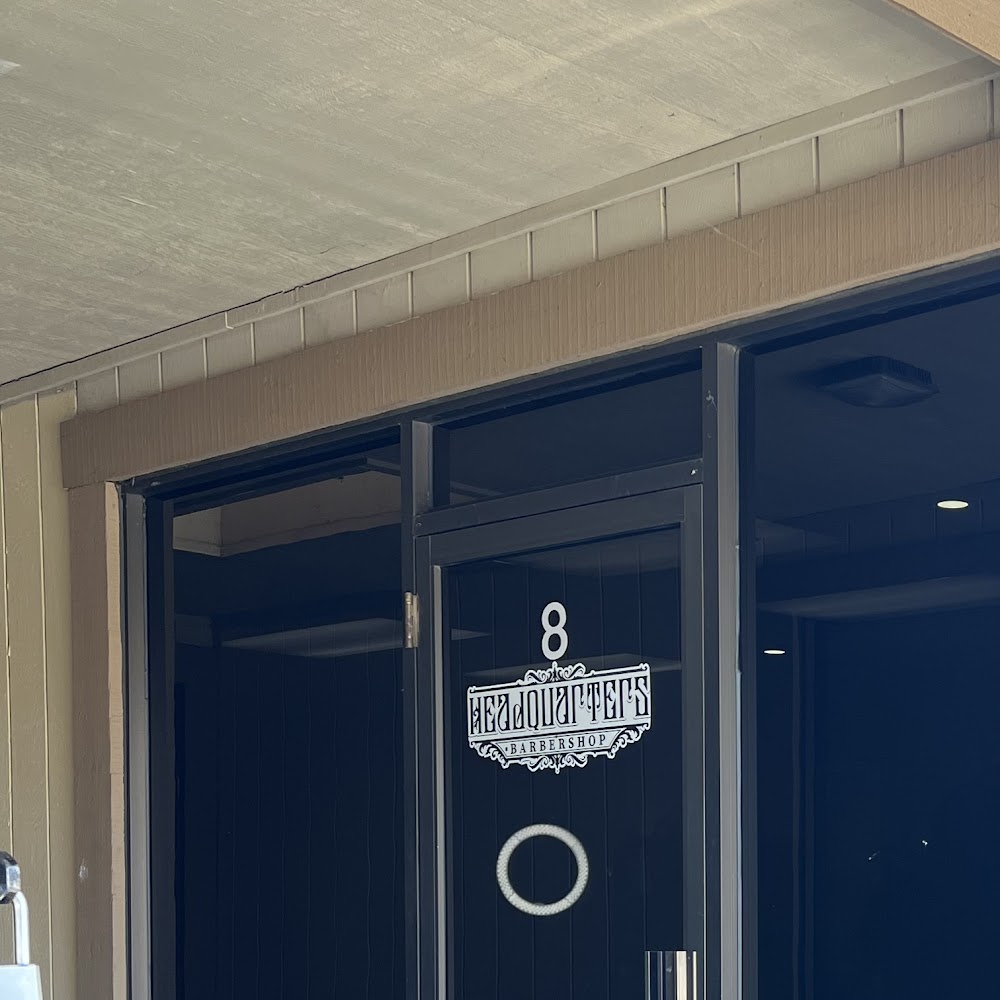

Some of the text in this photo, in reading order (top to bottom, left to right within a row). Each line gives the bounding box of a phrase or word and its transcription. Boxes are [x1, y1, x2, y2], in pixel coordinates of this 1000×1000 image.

[541, 601, 569, 661] 8
[469, 675, 649, 735] HEADQUARTERS
[510, 733, 606, 755] BARBERSHOP
